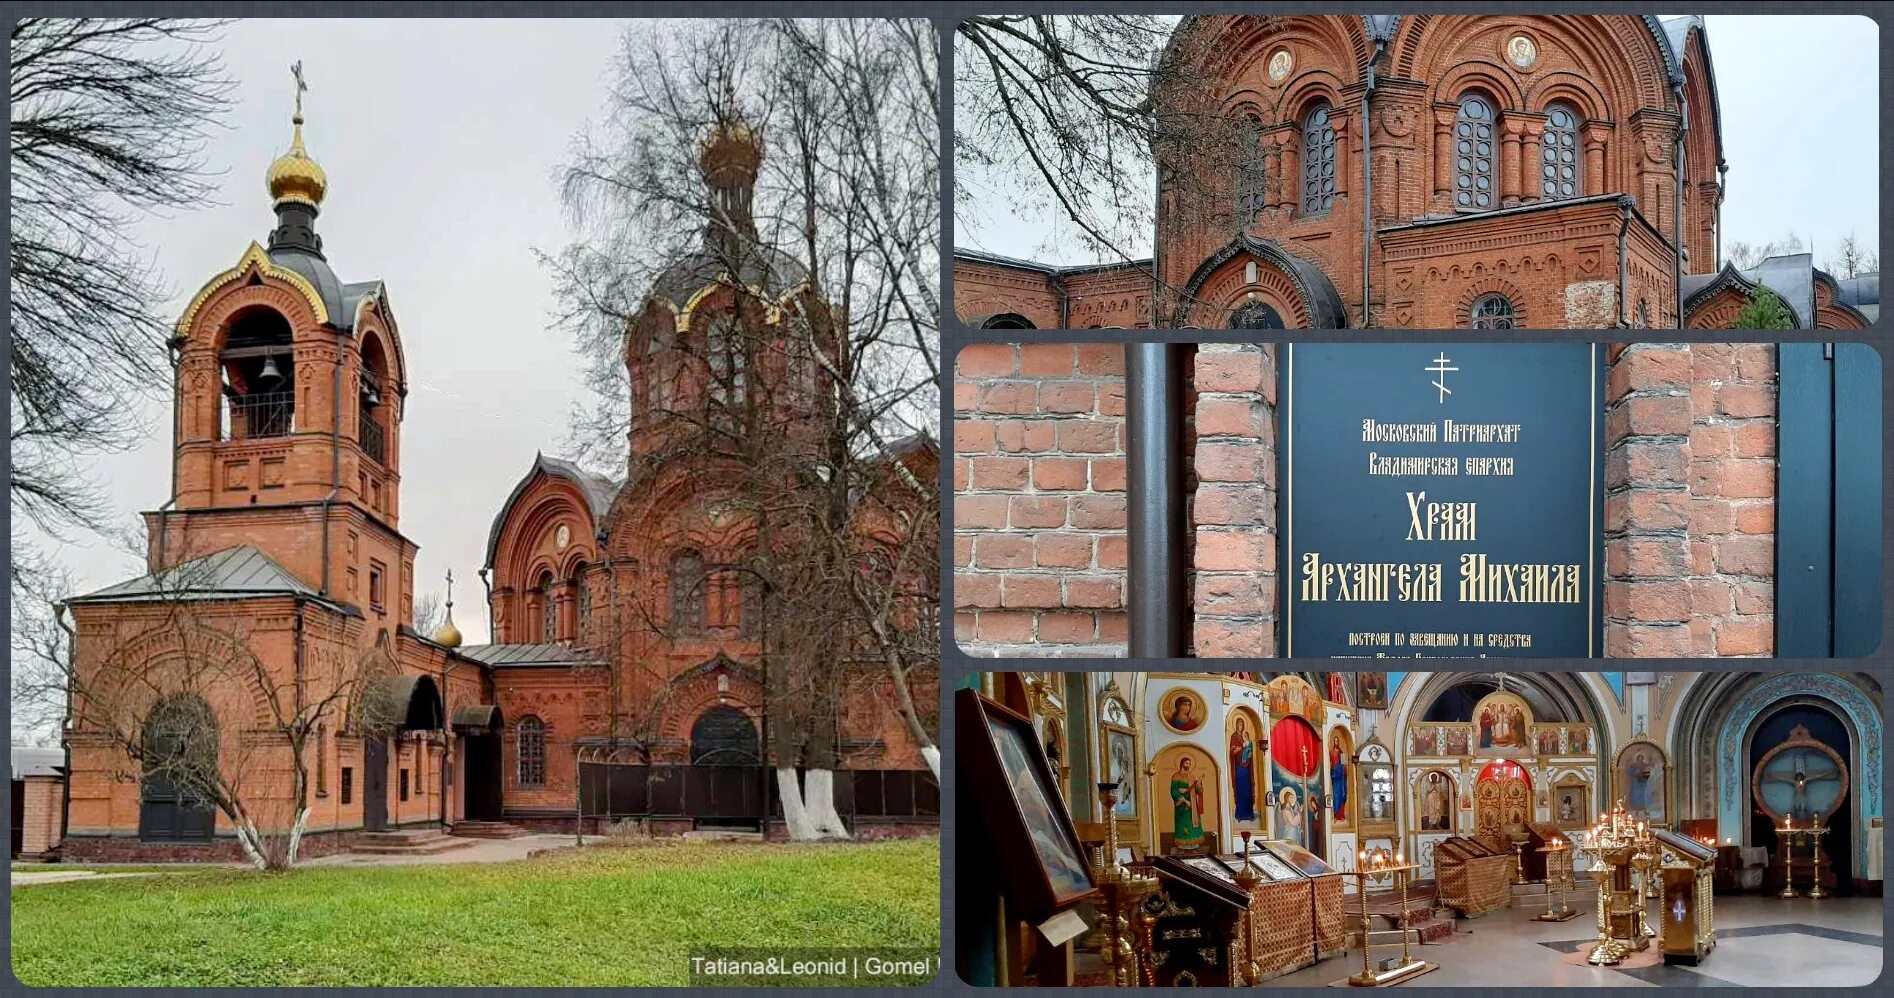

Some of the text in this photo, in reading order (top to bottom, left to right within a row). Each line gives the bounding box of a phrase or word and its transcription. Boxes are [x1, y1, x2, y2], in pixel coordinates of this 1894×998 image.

[1362, 418, 1521, 443] Московский Патриархат
[1369, 451, 1514, 478] Владимирская епархия
[1405, 490, 1477, 541] Храм
[1301, 552, 1581, 603] Архангела Михаила
